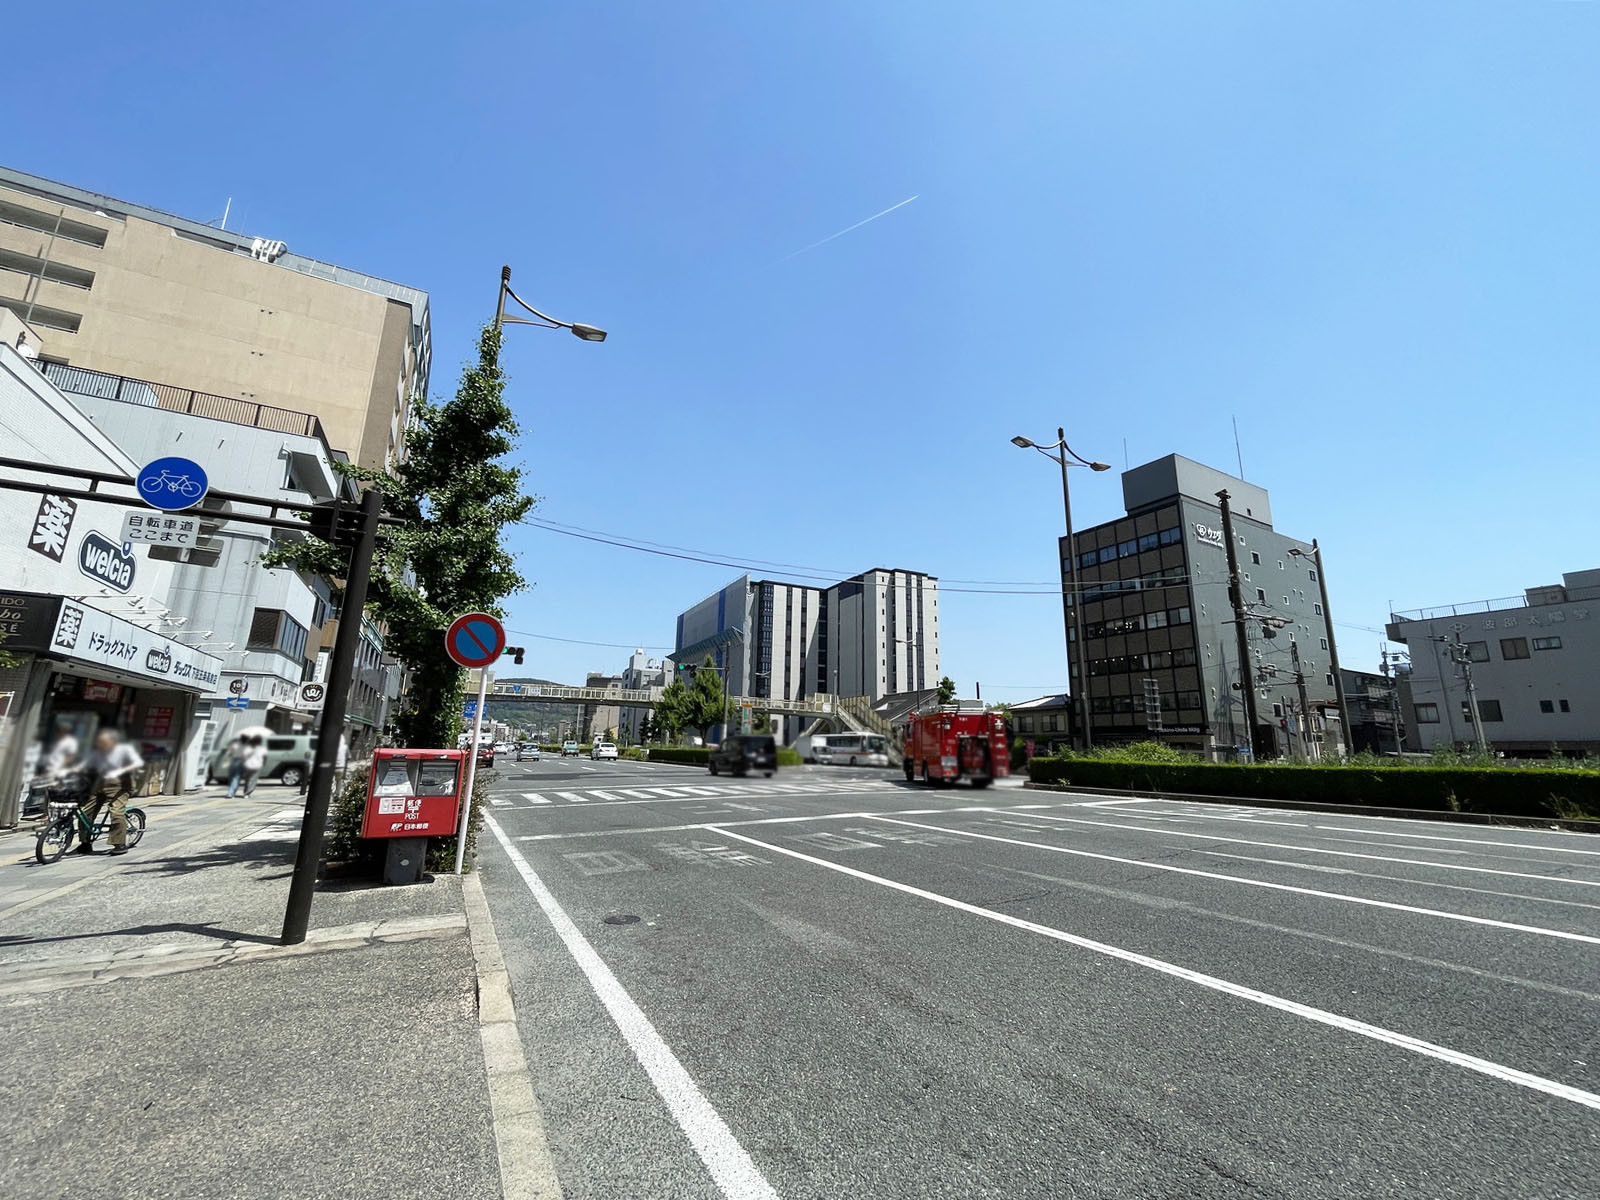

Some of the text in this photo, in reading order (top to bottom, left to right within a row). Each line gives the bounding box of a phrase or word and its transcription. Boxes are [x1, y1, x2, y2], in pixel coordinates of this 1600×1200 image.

[33, 493, 71, 556] 薬
[129, 515, 194, 532] 自転車道
[129, 528, 189, 544] ここまで
[56, 607, 81, 649] 薬
[88, 631, 138, 661] ドラッグストア
[404, 812, 419, 820] POST
